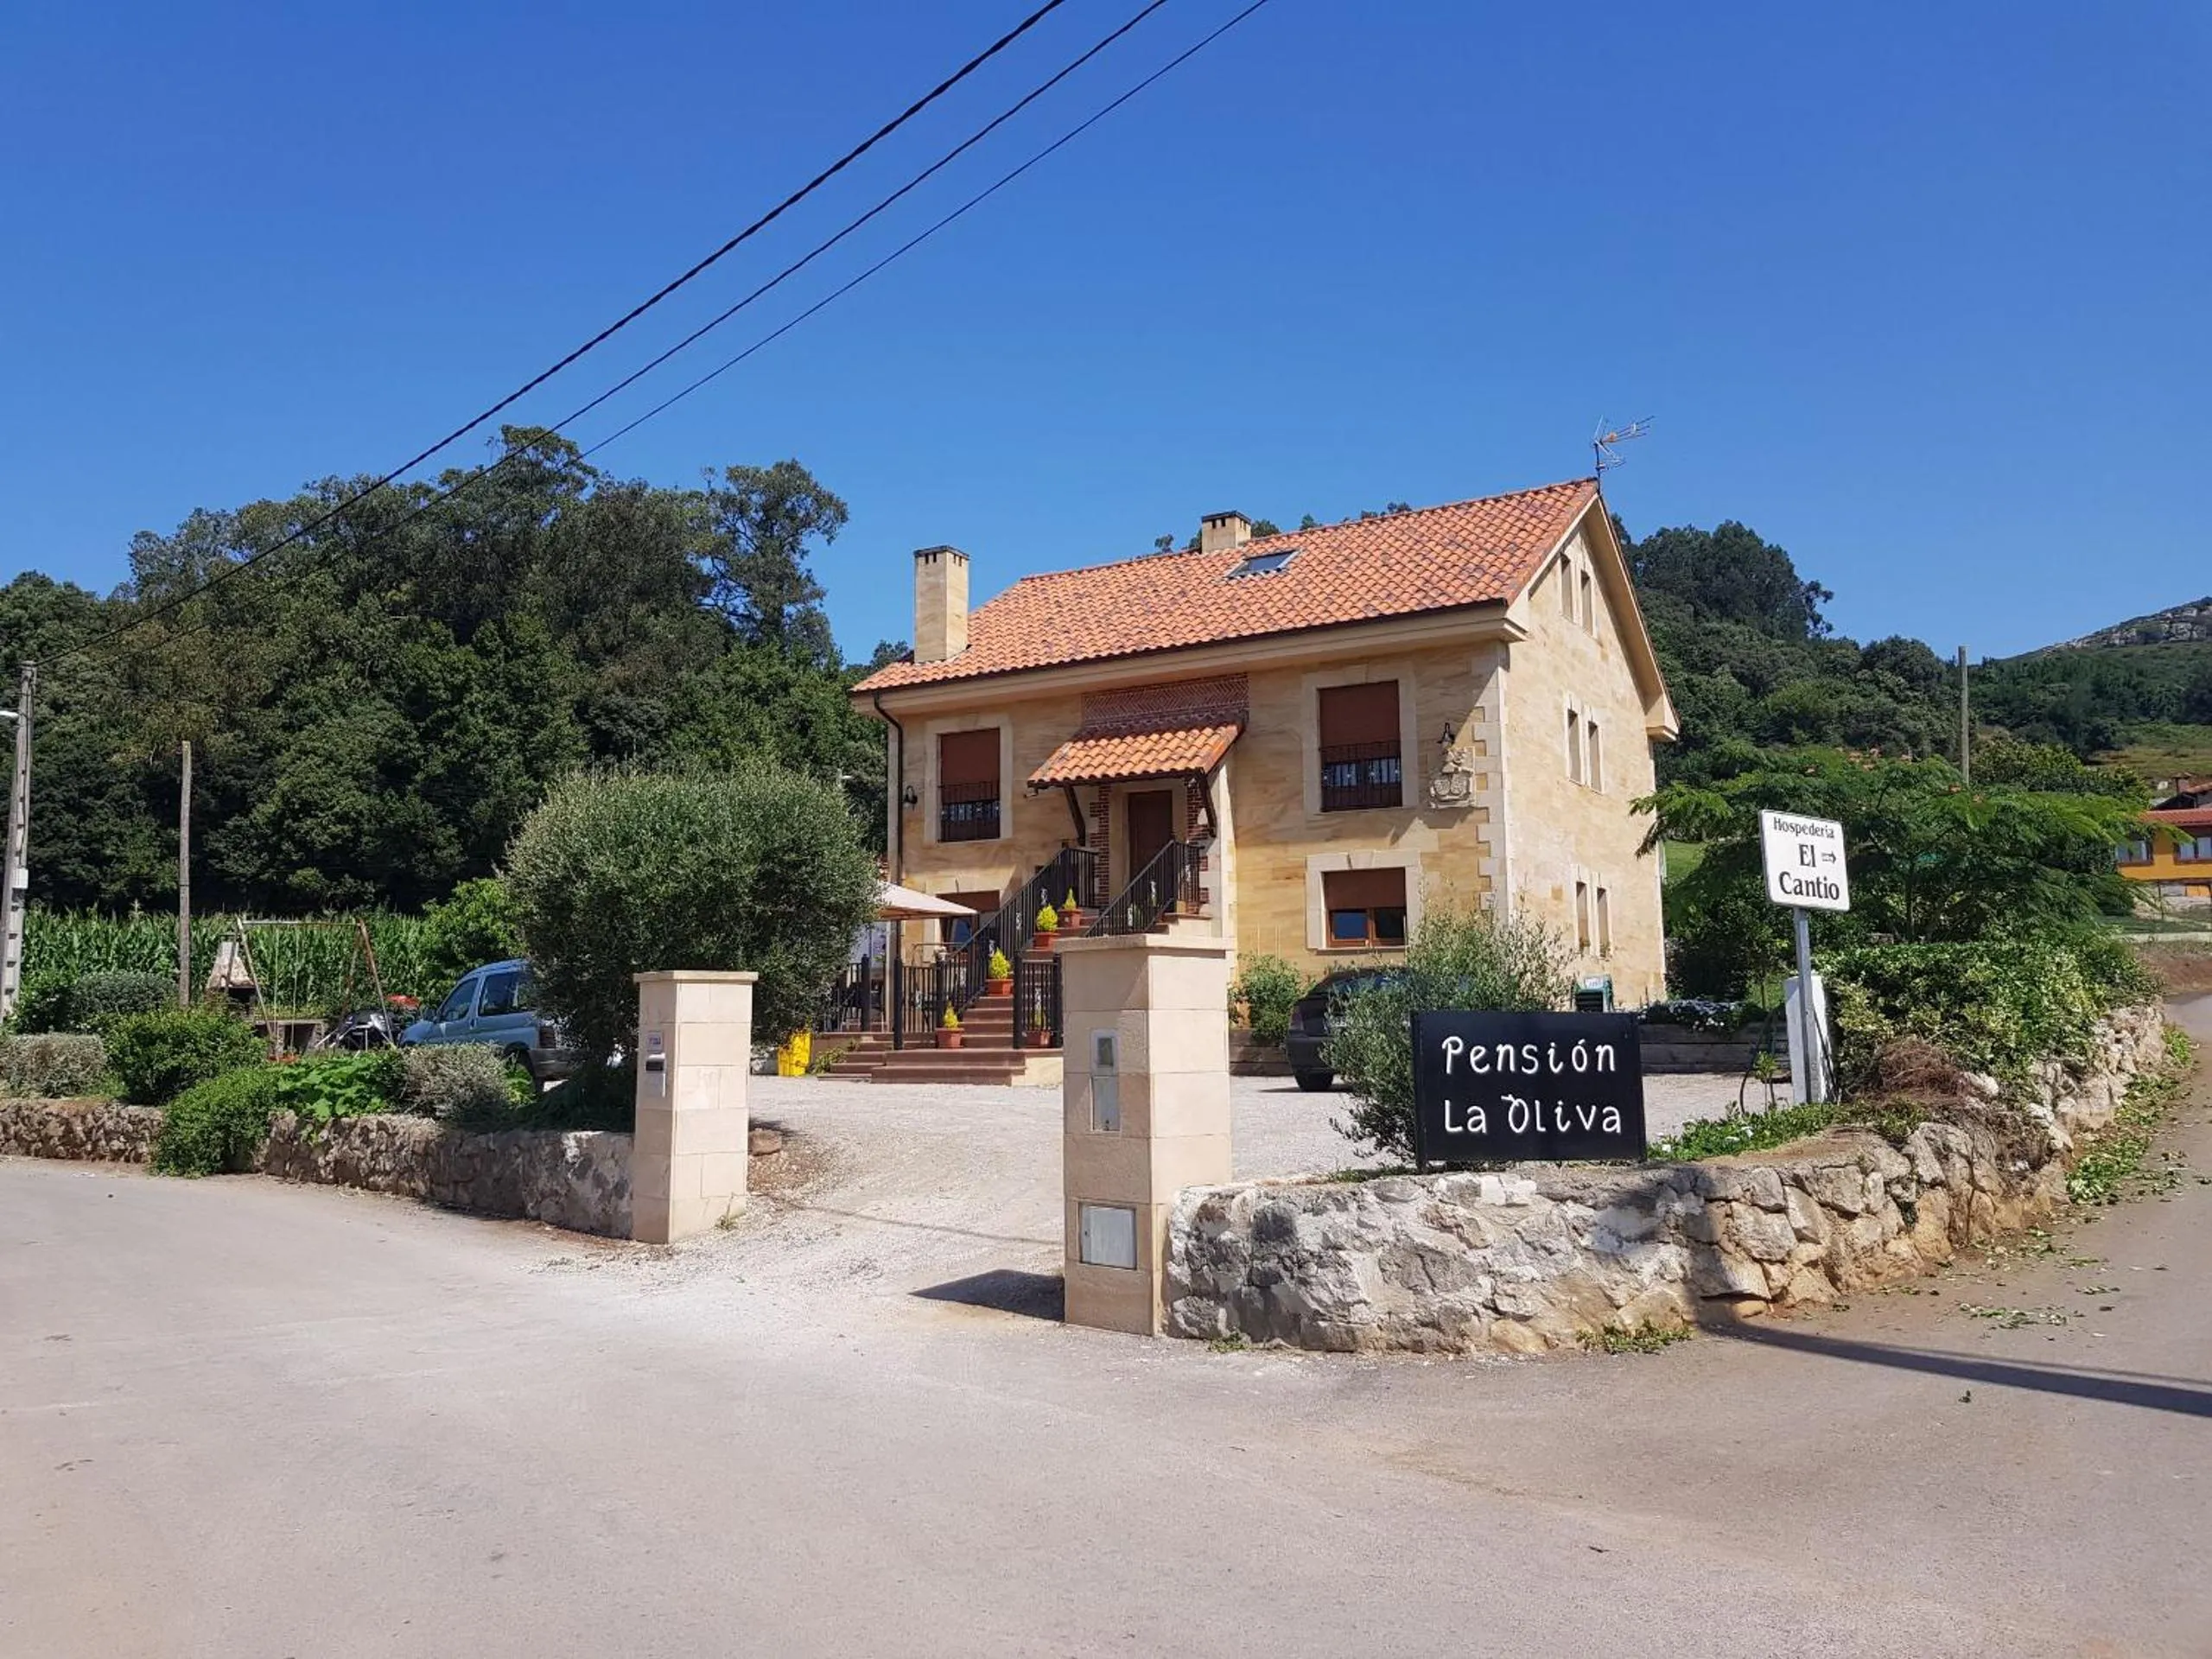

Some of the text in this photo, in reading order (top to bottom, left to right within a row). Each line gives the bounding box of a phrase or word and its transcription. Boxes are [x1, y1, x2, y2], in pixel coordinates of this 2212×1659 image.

[1799, 843, 1816, 868] El
[1778, 871, 1840, 900] Cantio
[1442, 1036, 1615, 1074] Pensión
[1444, 1093, 1621, 1134] La Oliva
